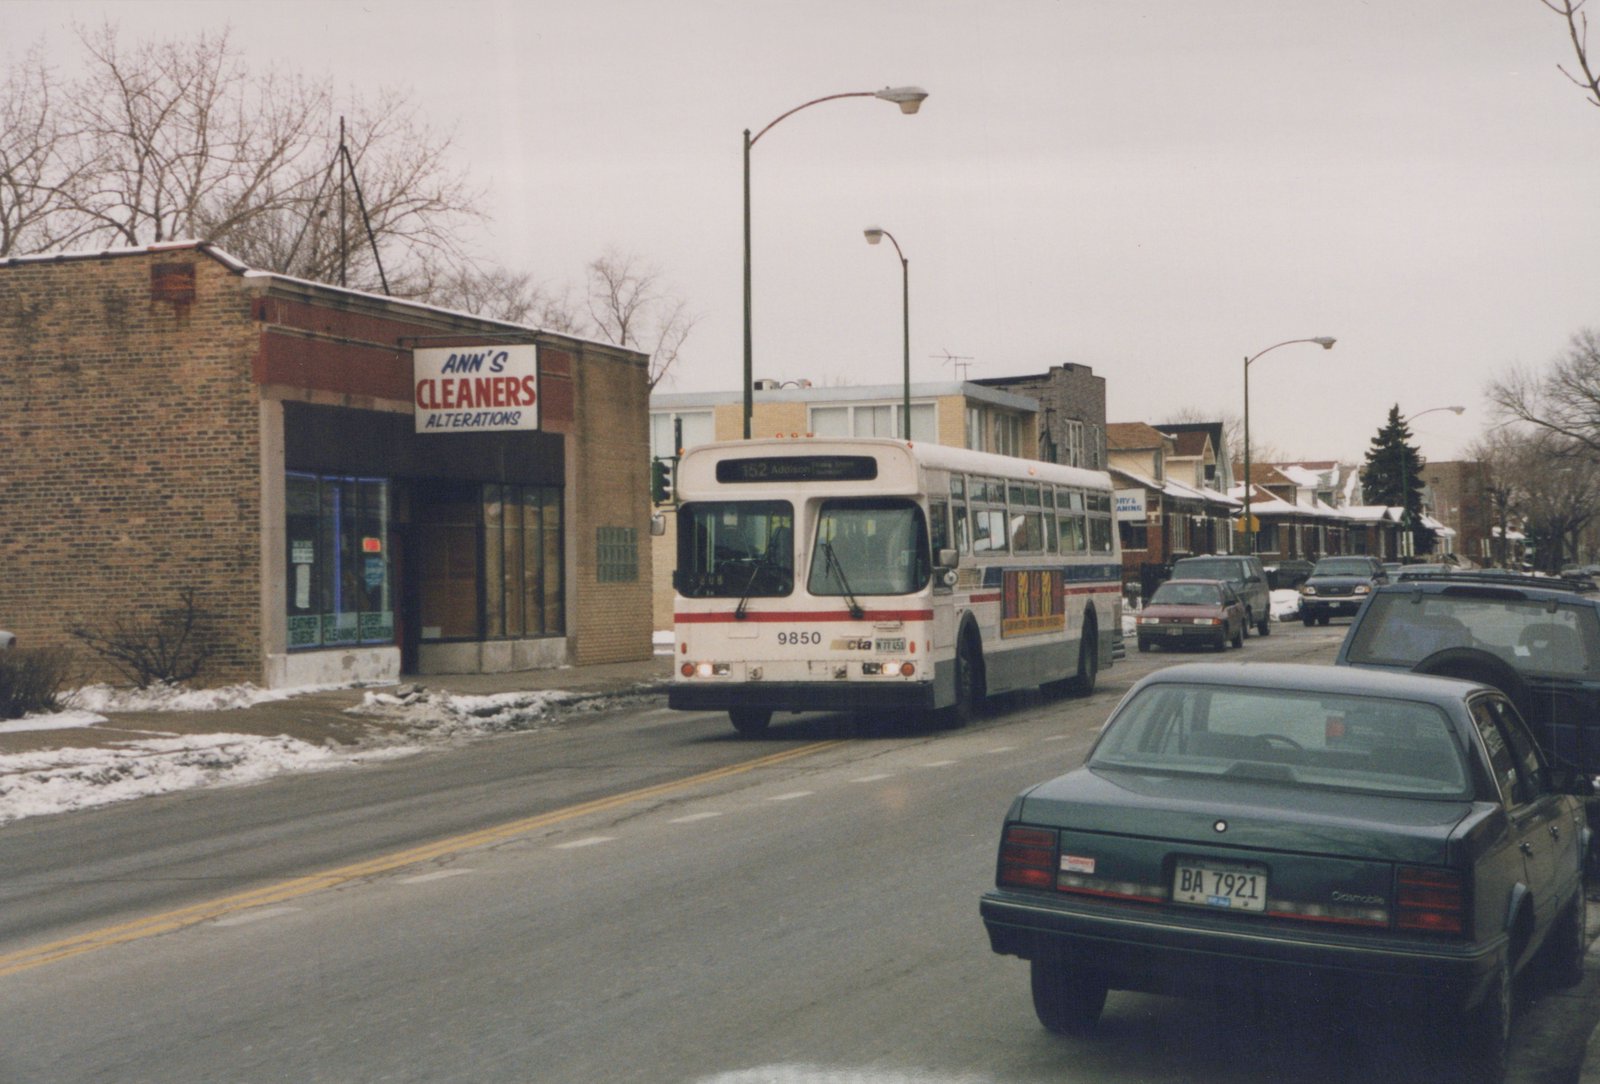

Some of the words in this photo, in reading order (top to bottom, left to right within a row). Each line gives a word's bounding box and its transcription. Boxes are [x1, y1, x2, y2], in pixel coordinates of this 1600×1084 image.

[441, 350, 509, 374] ANN'S
[416, 375, 536, 410] CLEANERS
[425, 411, 521, 428] ALTERATIONS
[742, 463, 768, 478] 152
[777, 631, 822, 646] 9850
[847, 638, 872, 650] cta
[1180, 868, 1204, 893] BA
[1212, 871, 1259, 900] 7921
